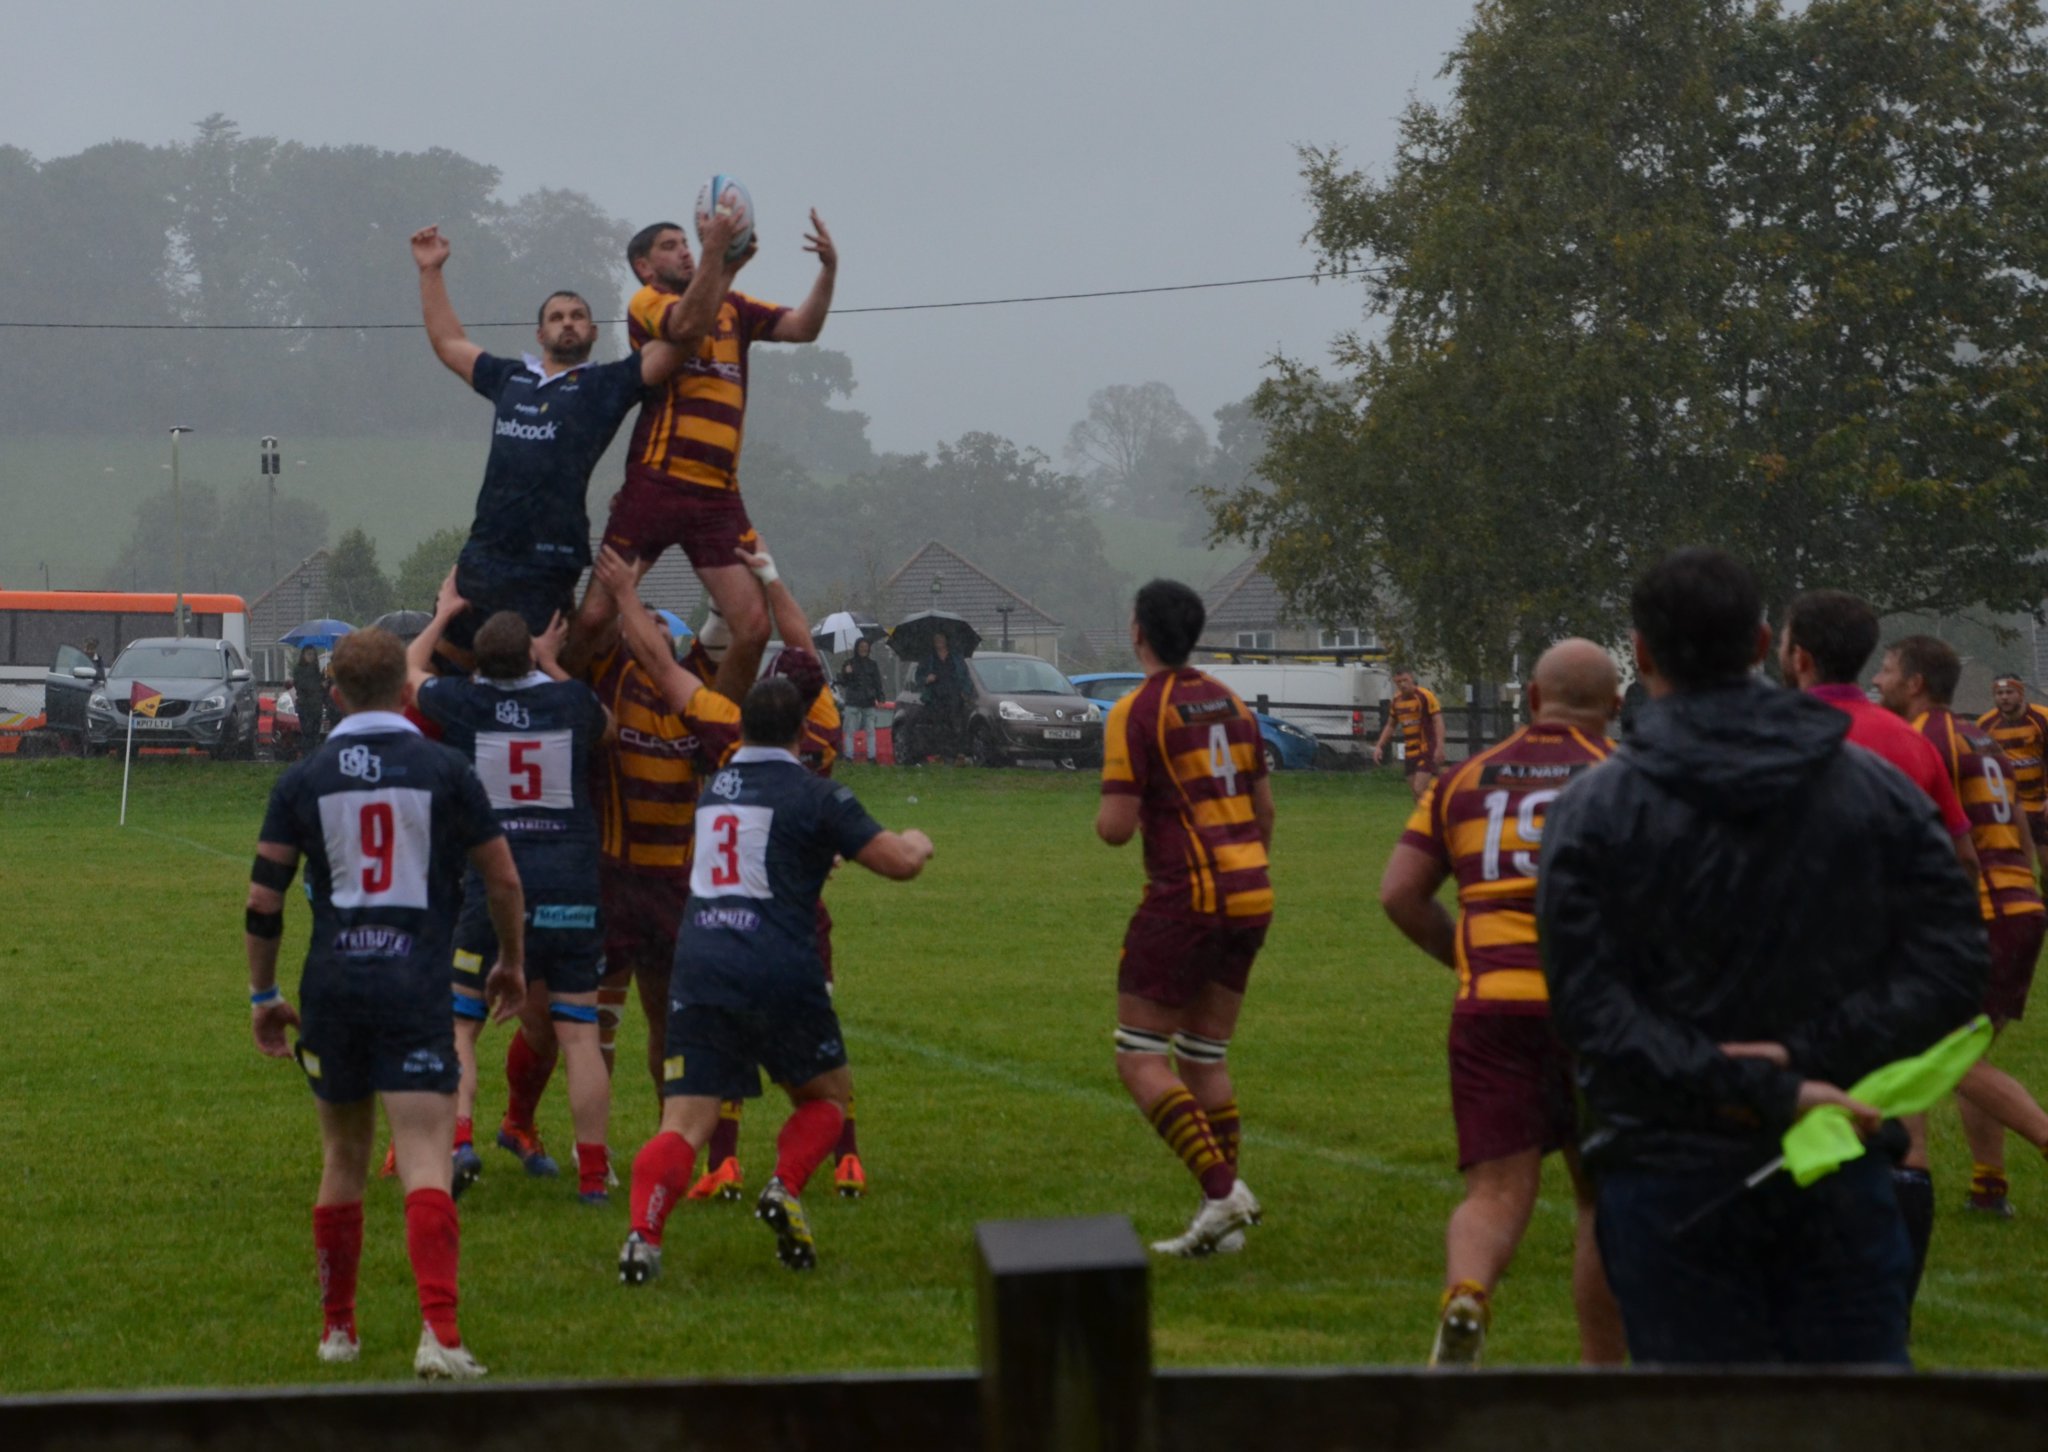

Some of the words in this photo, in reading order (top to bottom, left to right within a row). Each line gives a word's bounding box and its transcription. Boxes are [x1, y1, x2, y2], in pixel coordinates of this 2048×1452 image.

[508, 740, 543, 801] 5
[1209, 723, 1237, 796] 4
[1982, 756, 2012, 824] 9
[359, 801, 394, 895] 9
[711, 814, 740, 887] 3
